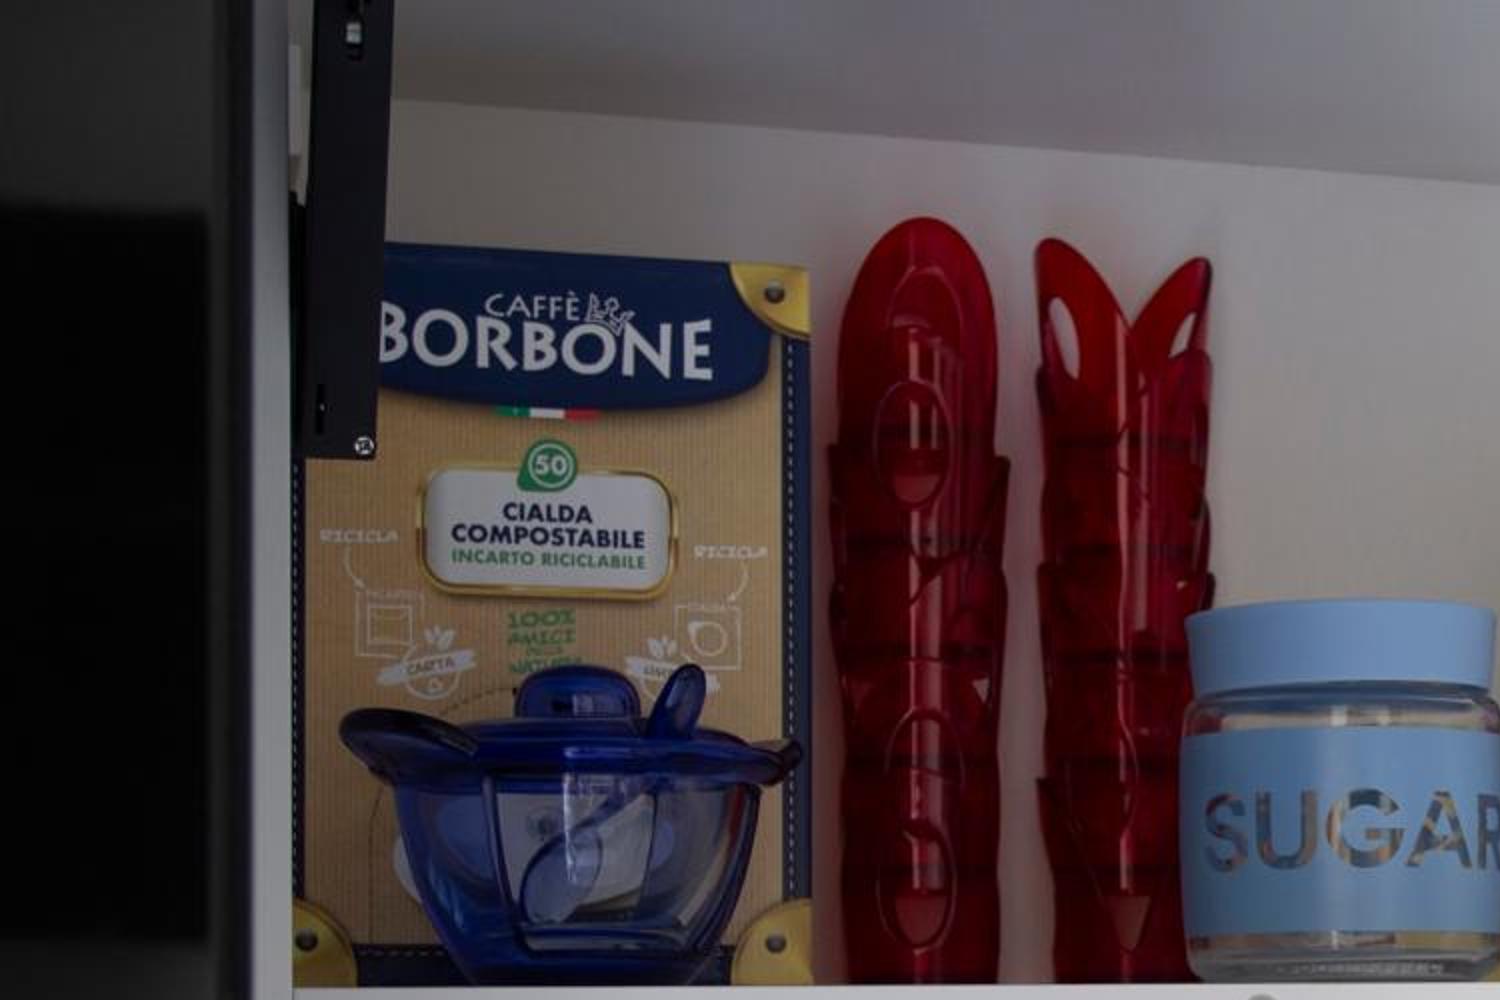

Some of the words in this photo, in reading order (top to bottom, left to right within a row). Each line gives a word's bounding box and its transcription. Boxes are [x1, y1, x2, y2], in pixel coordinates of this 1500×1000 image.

[484, 291, 580, 321] CAFFÈ
[379, 300, 713, 381] BORBONE
[535, 454, 568, 476] 50
[502, 500, 593, 526] CIALDA
[450, 522, 645, 550] COMPOSTABILE
[450, 548, 536, 568] INCARTO
[540, 550, 646, 571] RICICLABILE
